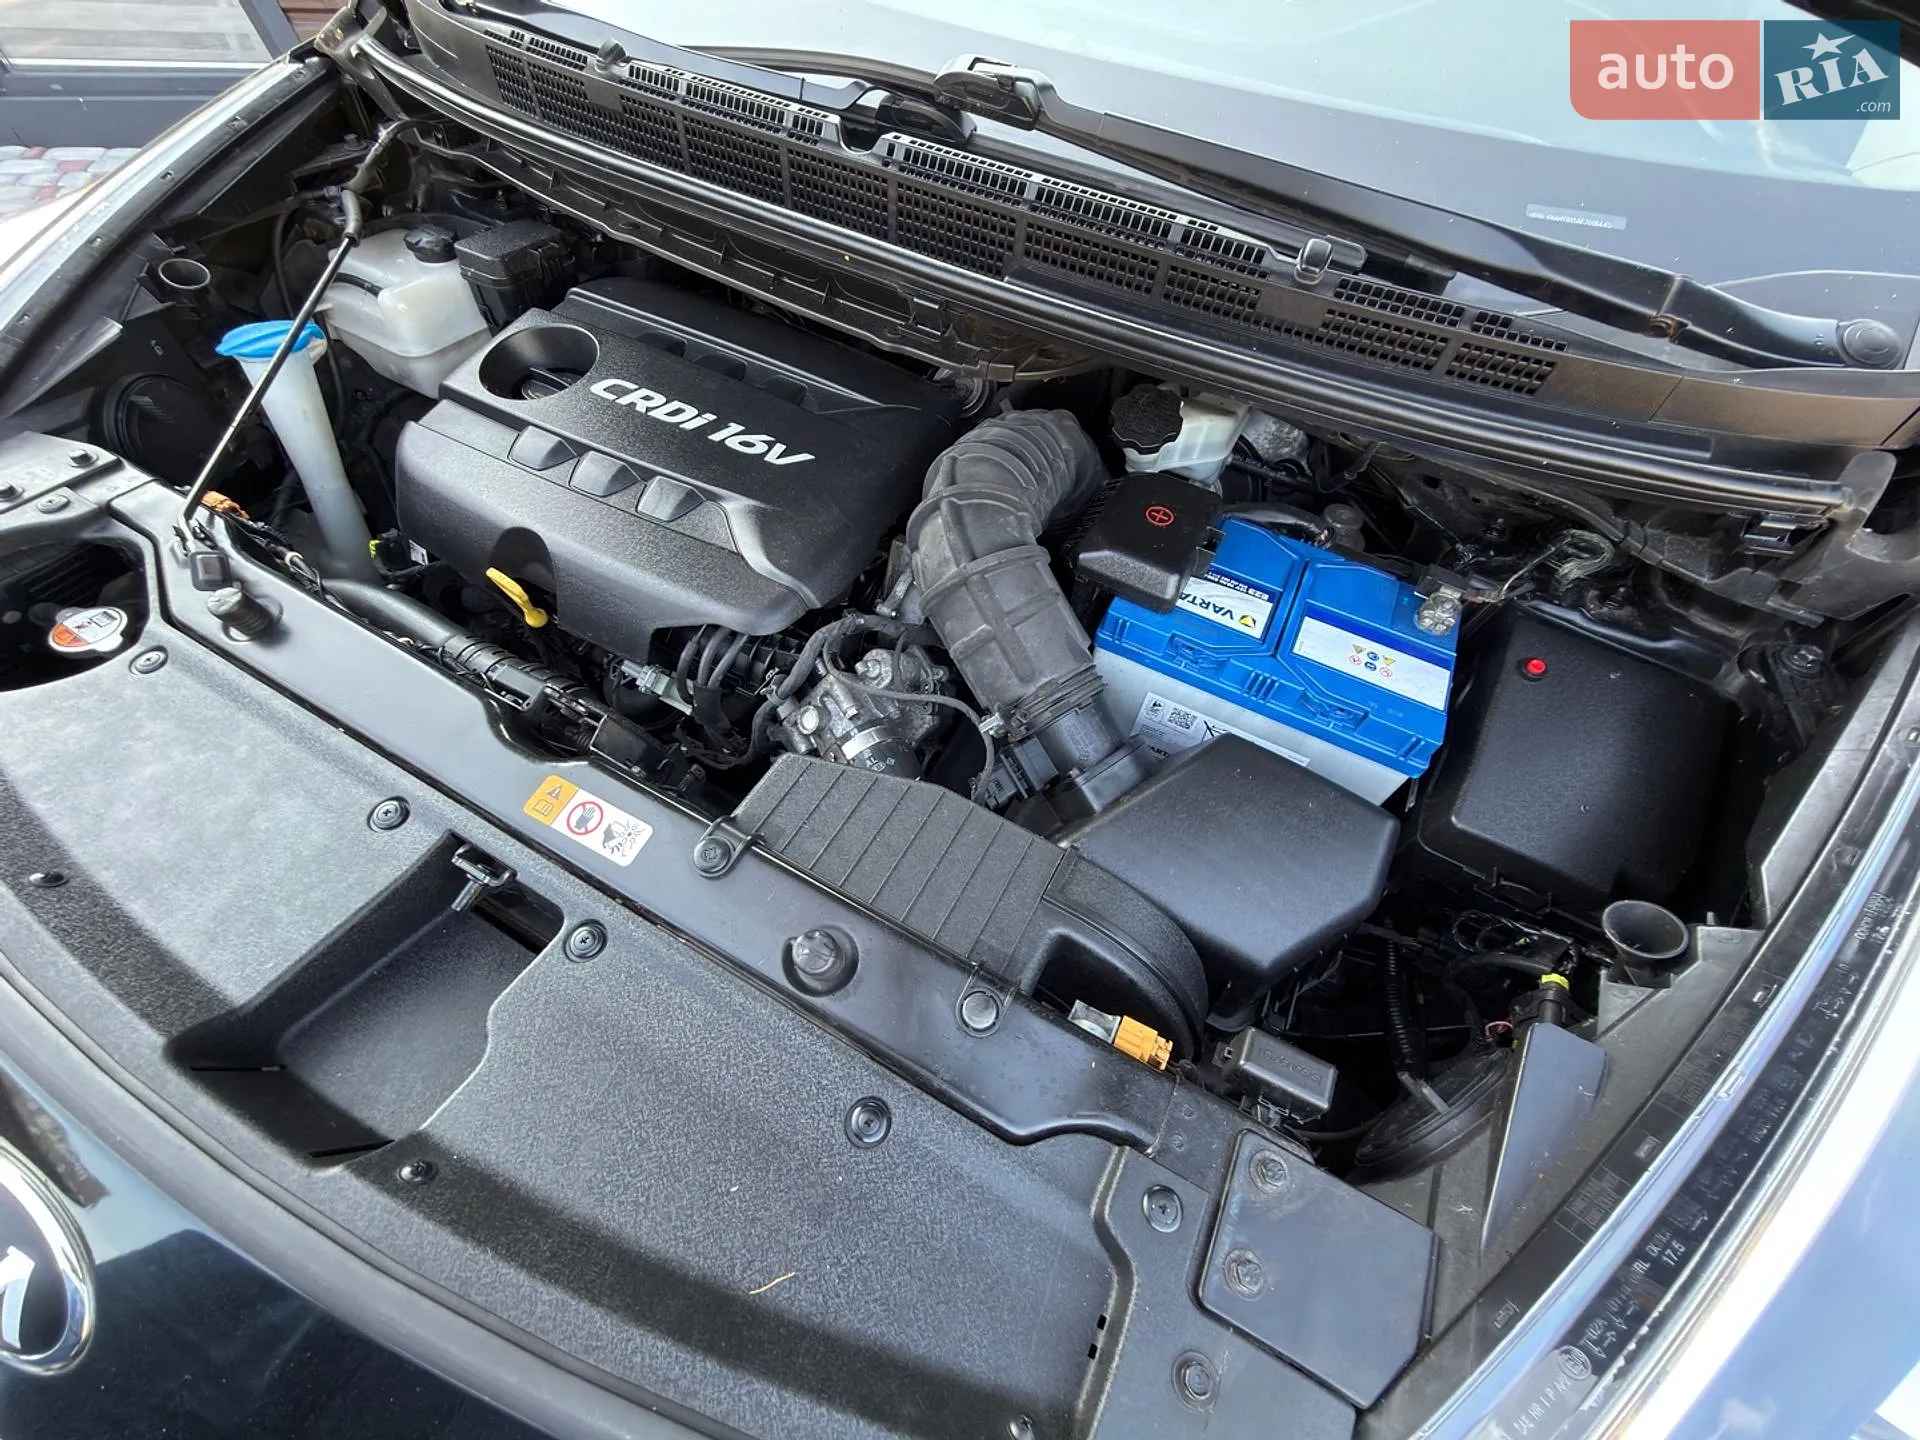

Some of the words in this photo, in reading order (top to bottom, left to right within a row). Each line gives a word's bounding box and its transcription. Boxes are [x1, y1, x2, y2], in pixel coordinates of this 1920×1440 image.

[589, 378, 718, 430] CRDi
[707, 422, 816, 465] 16V
[1179, 591, 1234, 620] VARTA
